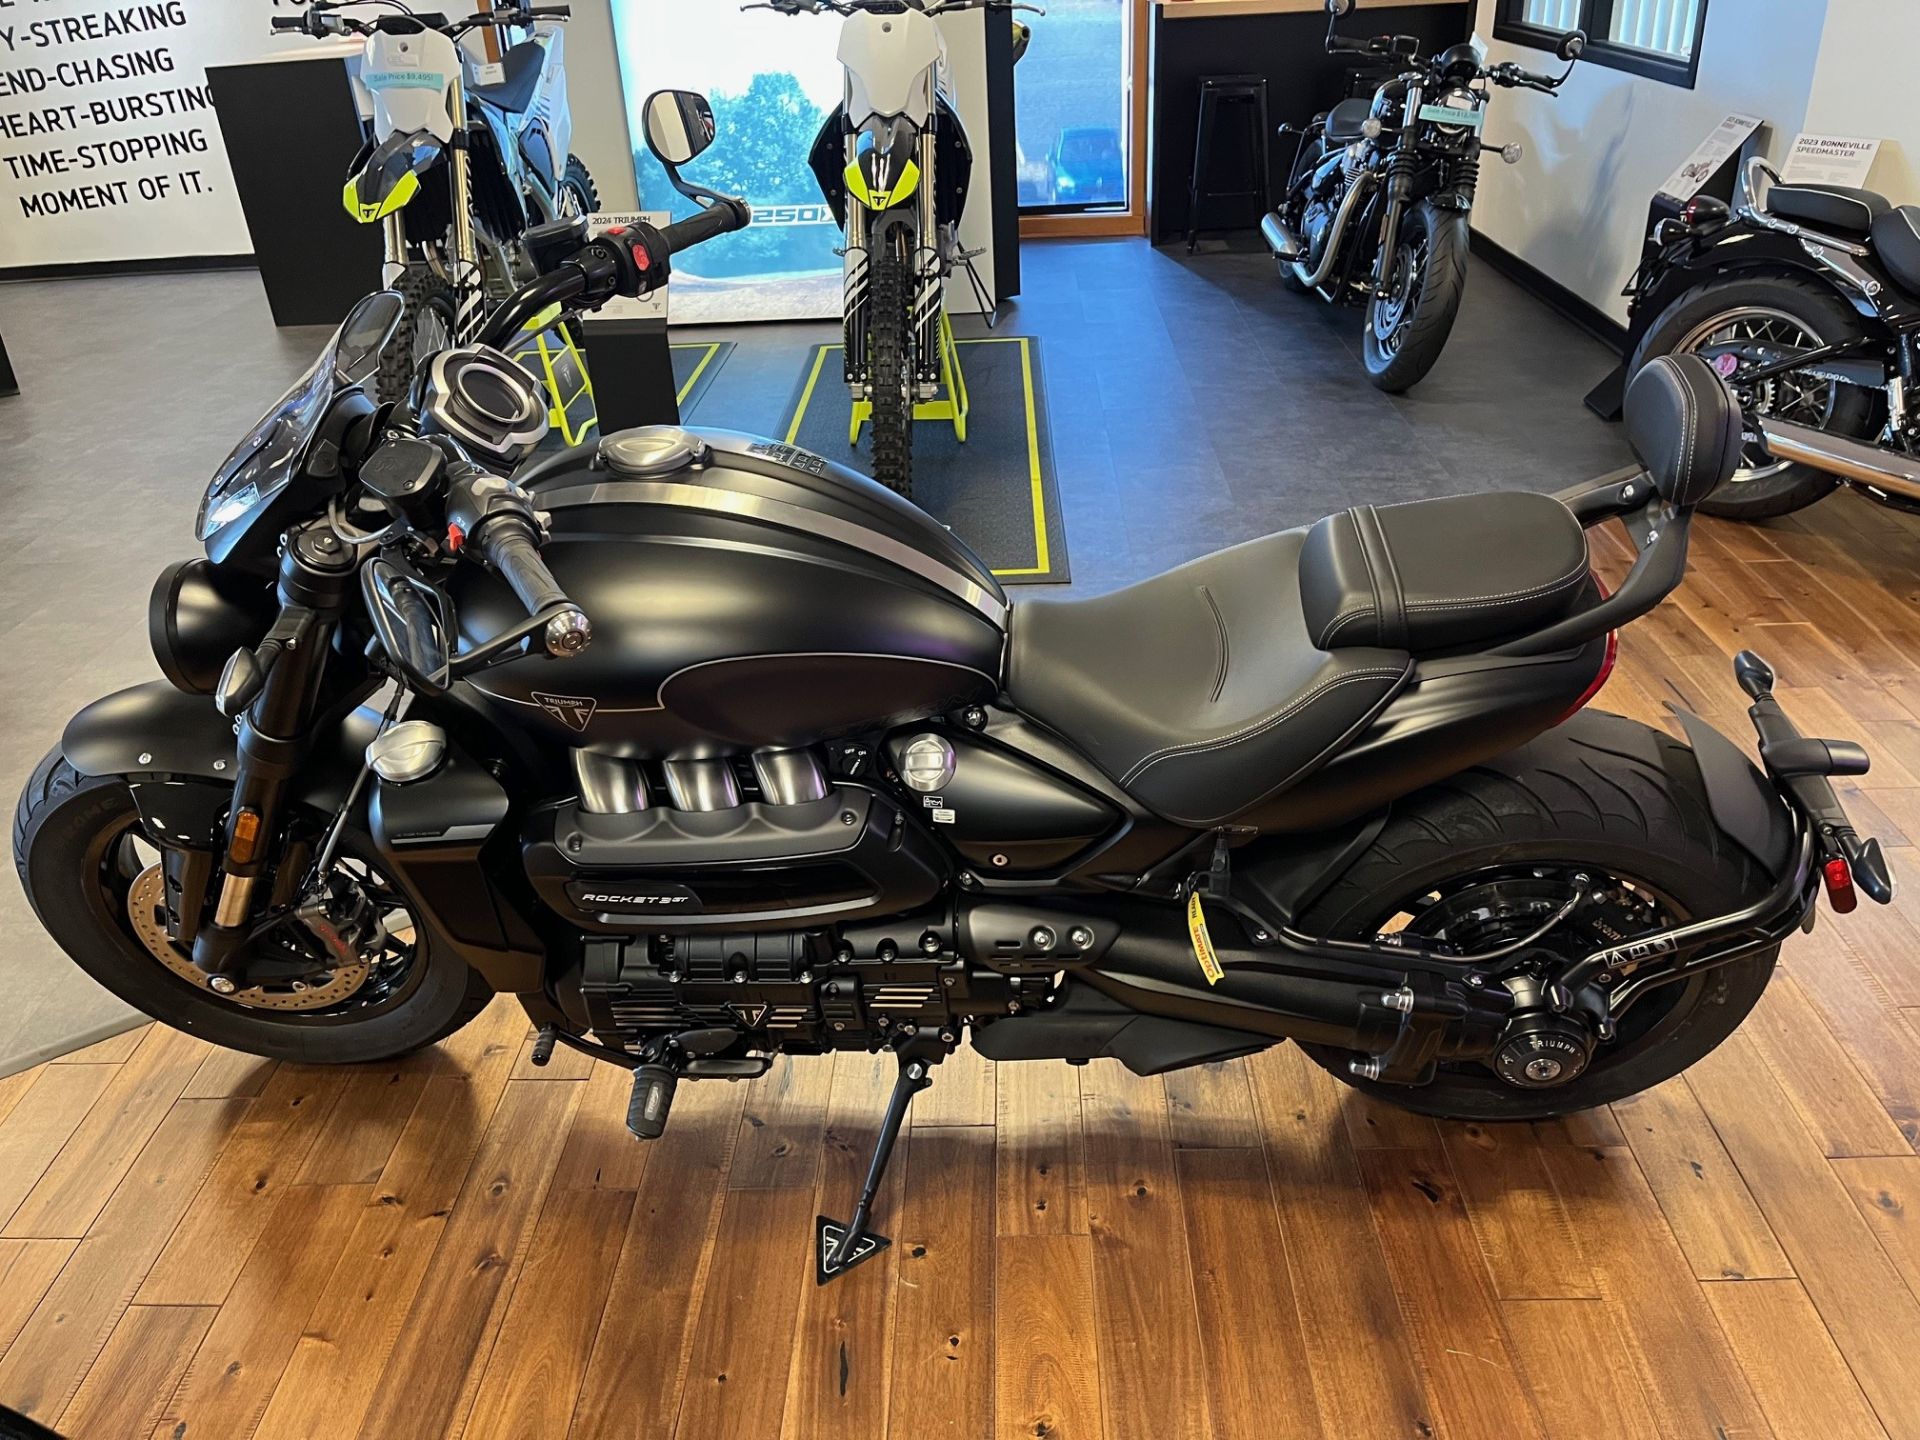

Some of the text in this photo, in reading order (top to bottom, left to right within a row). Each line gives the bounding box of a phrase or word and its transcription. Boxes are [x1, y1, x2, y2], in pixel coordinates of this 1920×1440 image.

[388, 72, 405, 80] Price
[1798, 138, 1873, 151] 2023 BONNEVILLE
[3, 128, 208, 179] TIME-STOPPING
[1795, 146, 1856, 158] SPEEDMASTER
[19, 170, 213, 218] MOMENT OF IT.
[592, 215, 651, 225] 2024 TRIUMPH
[544, 697, 583, 707] TRIUMPH
[1529, 1039, 1576, 1054] TRIUMPH
